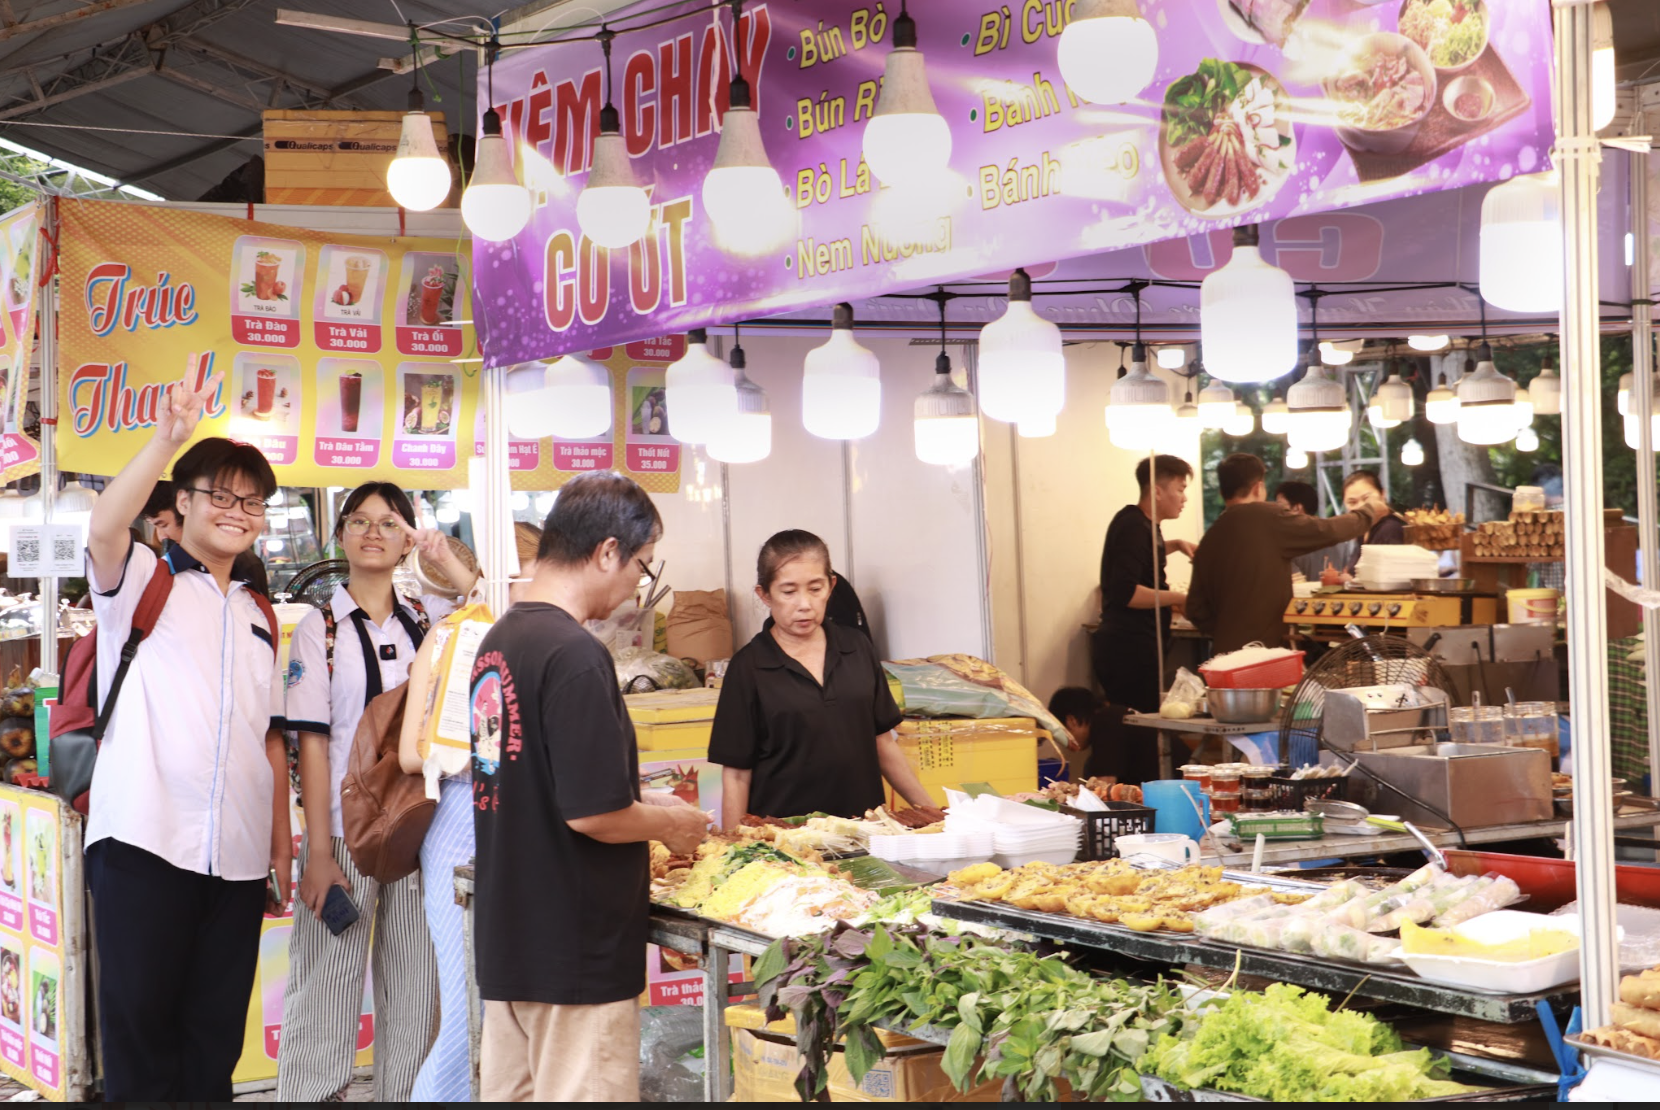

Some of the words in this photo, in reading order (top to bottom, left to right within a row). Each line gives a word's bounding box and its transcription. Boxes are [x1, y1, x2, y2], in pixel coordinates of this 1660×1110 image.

[798, 19, 848, 70] Bún
[849, 2, 888, 51] Bò
[973, 4, 1012, 58] Bì
[796, 89, 846, 140] Bún
[288, 140, 333, 151] Qualicaps
[352, 141, 397, 152] Qualicaps
[796, 162, 833, 210] Bò
[839, 150, 872, 200] Lá
[979, 151, 1062, 211] Bánh
[797, 236, 854, 280] Nem
[83, 262, 200, 338] Trúc
[244, 319, 263, 330] Trà
[265, 321, 288, 332] Đào
[328, 326, 347, 337] Trà
[349, 327, 368, 338] Vải
[411, 331, 429, 341] Trà
[247, 332, 286, 344] 30.000
[330, 338, 368, 349] 30.000
[411, 343, 449, 353] 30.000
[643, 348, 671, 358] 30.000
[68, 350, 227, 439] Thah
[318, 441, 334, 451] Trà
[401, 443, 428, 453] Chanh
[559, 446, 572, 456] Trà
[637, 447, 656, 457] Thốt
[331, 455, 362, 465] 30.000
[409, 457, 439, 467] 30.000
[570, 459, 595, 468] 30.000
[640, 460, 668, 469] 35.000
[660, 985, 679, 997] Trà
